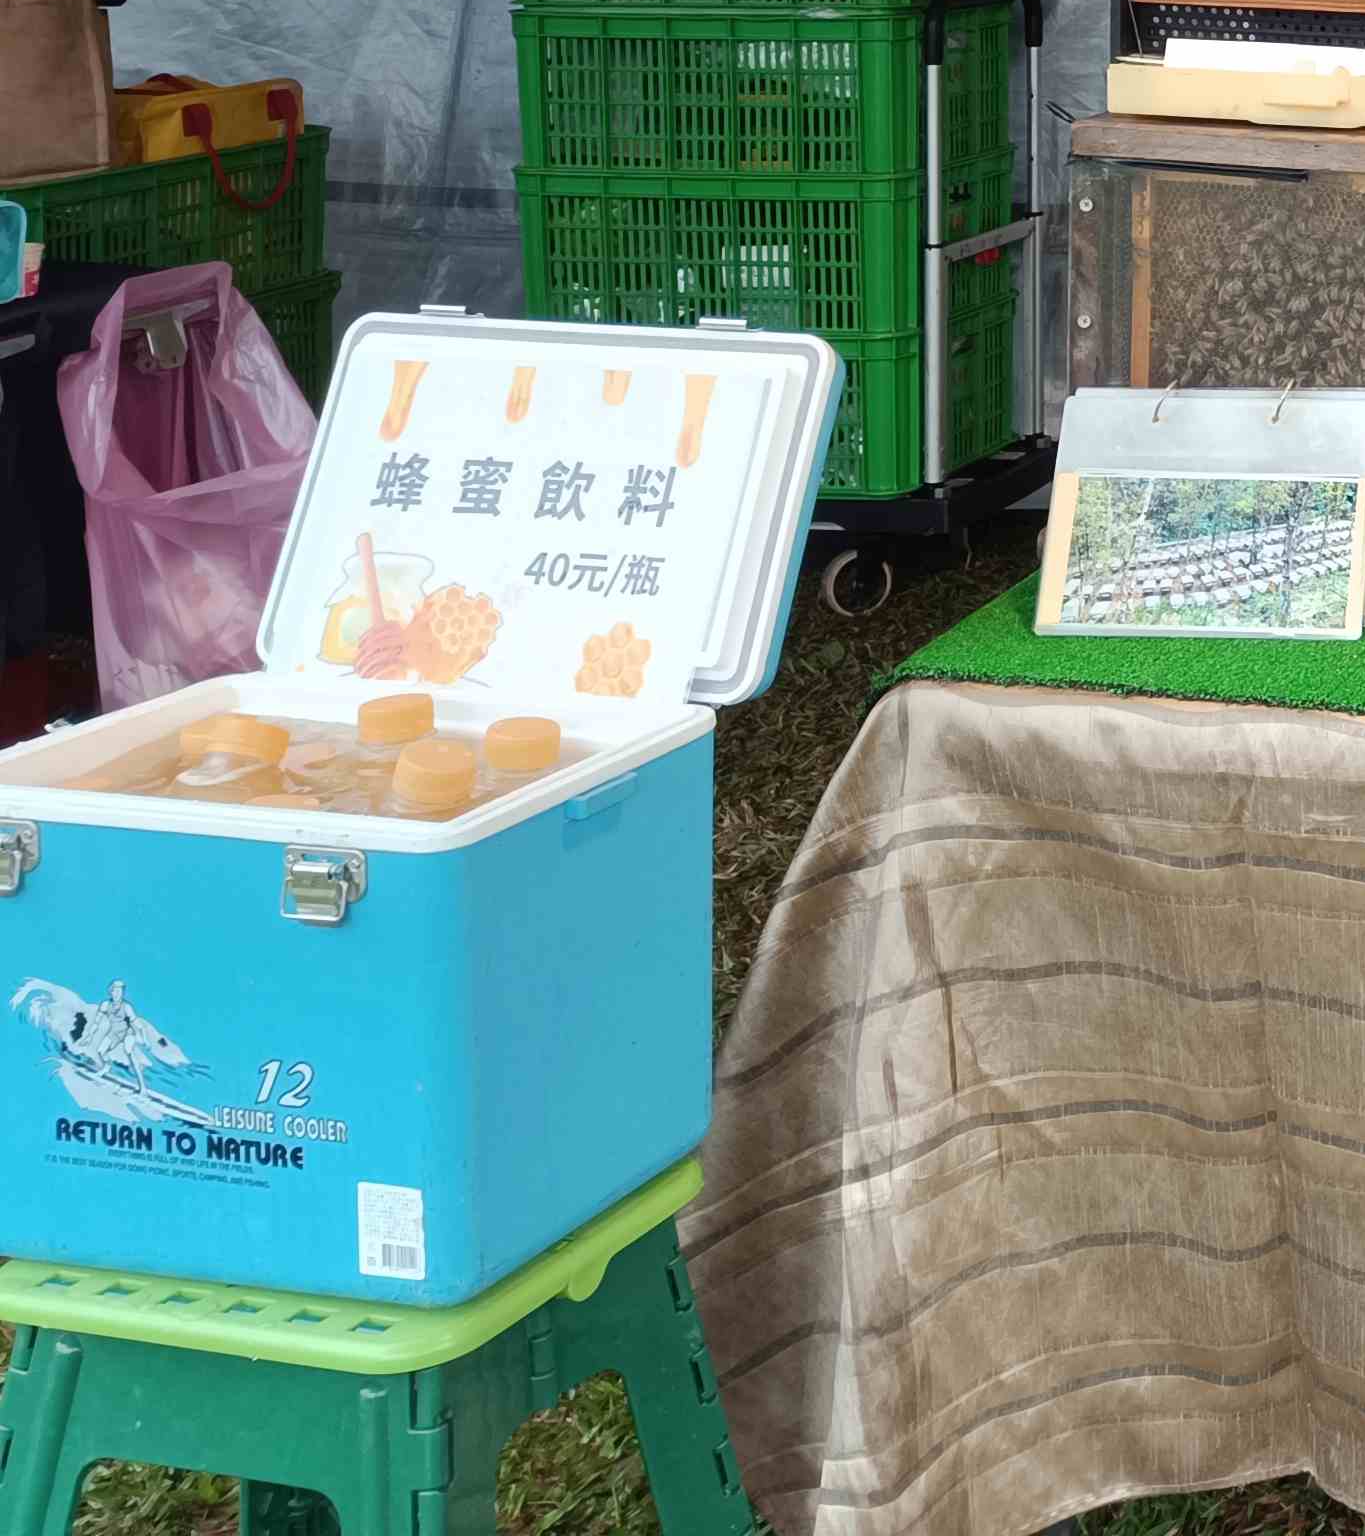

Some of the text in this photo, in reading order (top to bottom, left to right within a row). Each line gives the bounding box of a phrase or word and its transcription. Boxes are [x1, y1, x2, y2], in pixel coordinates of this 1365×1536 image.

[369, 451, 678, 528] 蜂蜜飲料
[524, 551, 666, 598] 40元/瓶
[255, 1058, 315, 1108] 12
[55, 1116, 153, 1151] RETURN
[161, 1129, 197, 1156] TO
[206, 1131, 304, 1170] NATURE
[213, 1104, 348, 1145] LEISURE COOLER
